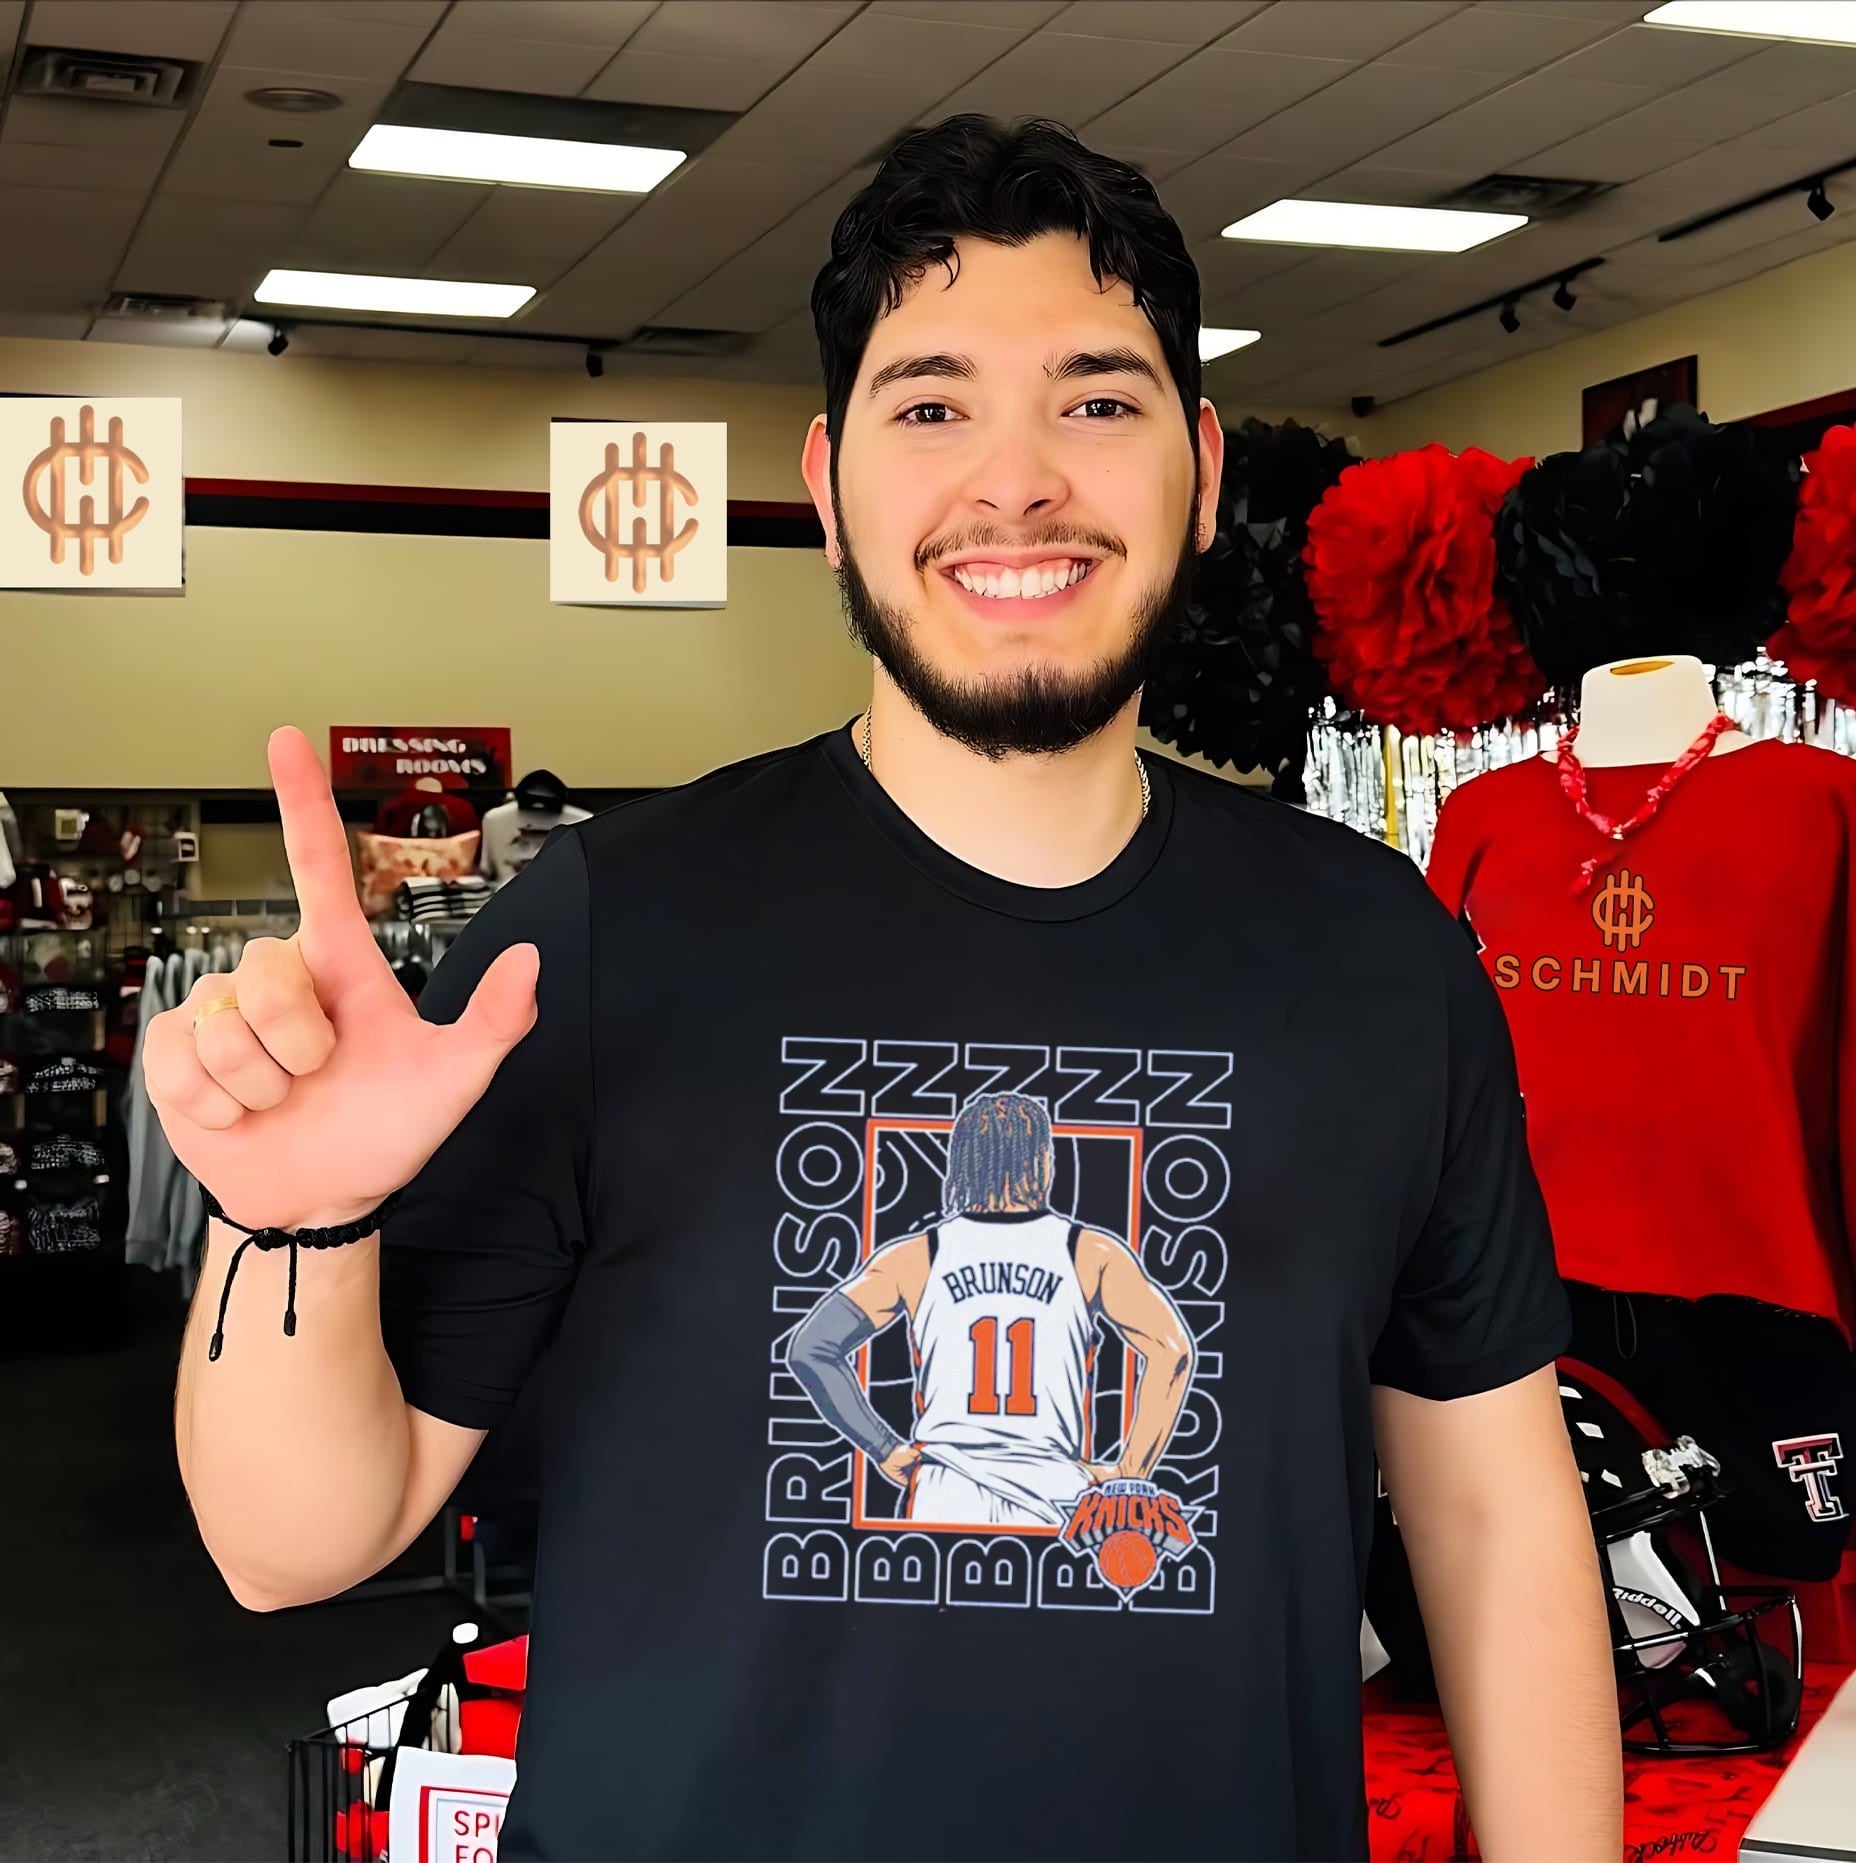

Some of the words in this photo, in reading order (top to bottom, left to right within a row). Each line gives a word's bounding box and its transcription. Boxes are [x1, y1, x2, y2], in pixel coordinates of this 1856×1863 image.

[342, 737, 467, 753] DRESSING
[396, 758, 487, 775] ROOMS
[1494, 953, 1747, 1000] SCHMIDT
[942, 1262, 1064, 1305] BRUNSON
[968, 1316, 1037, 1416] 11
[1104, 1483, 1127, 1496] NEW
[1129, 1483, 1157, 1497] YORK
[1064, 1493, 1193, 1546] KNICKS
